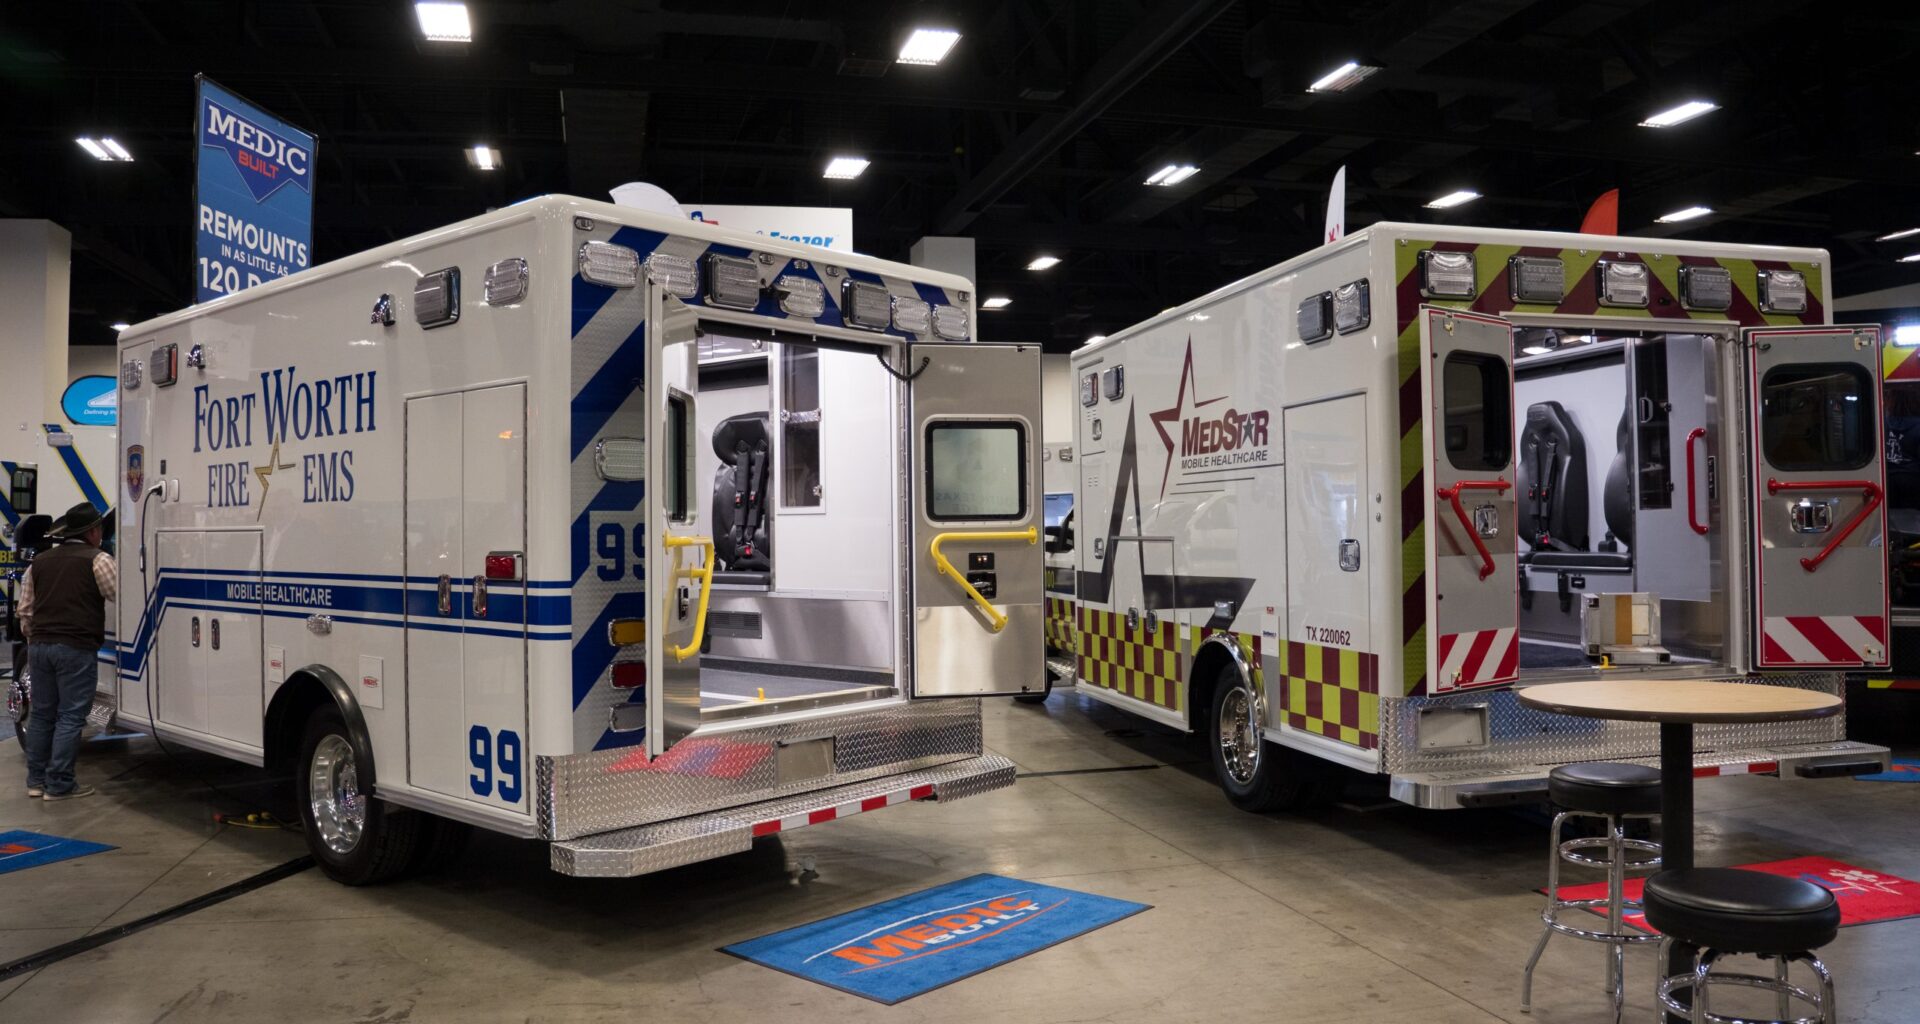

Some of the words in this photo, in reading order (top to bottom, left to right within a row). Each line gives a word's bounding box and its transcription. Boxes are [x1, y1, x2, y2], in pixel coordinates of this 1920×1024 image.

[207, 104, 307, 176] MEDIC
[238, 150, 279, 179] BUILT
[200, 203, 308, 268] REMOUNTS
[199, 256, 240, 295] 120
[221, 243, 232, 259] IN
[233, 249, 246, 264] AS
[247, 253, 276, 274] LITTLE
[277, 264, 289, 278] AS
[193, 383, 256, 453] FORT
[260, 365, 377, 445] WORTH
[207, 461, 250, 508] FIRE
[303, 449, 354, 503] EMS
[1181, 456, 1209, 470] MOBILE
[1210, 449, 1268, 466] HEALTHCARE
[226, 583, 262, 600] MOBILE
[263, 584, 333, 607] HEALTHCARE
[1305, 625, 1318, 642] TX
[1319, 628, 1351, 646] 220062
[469, 724, 522, 804] 99
[831, 897, 1032, 967] MEDIC
[922, 901, 1040, 945] BUILT
